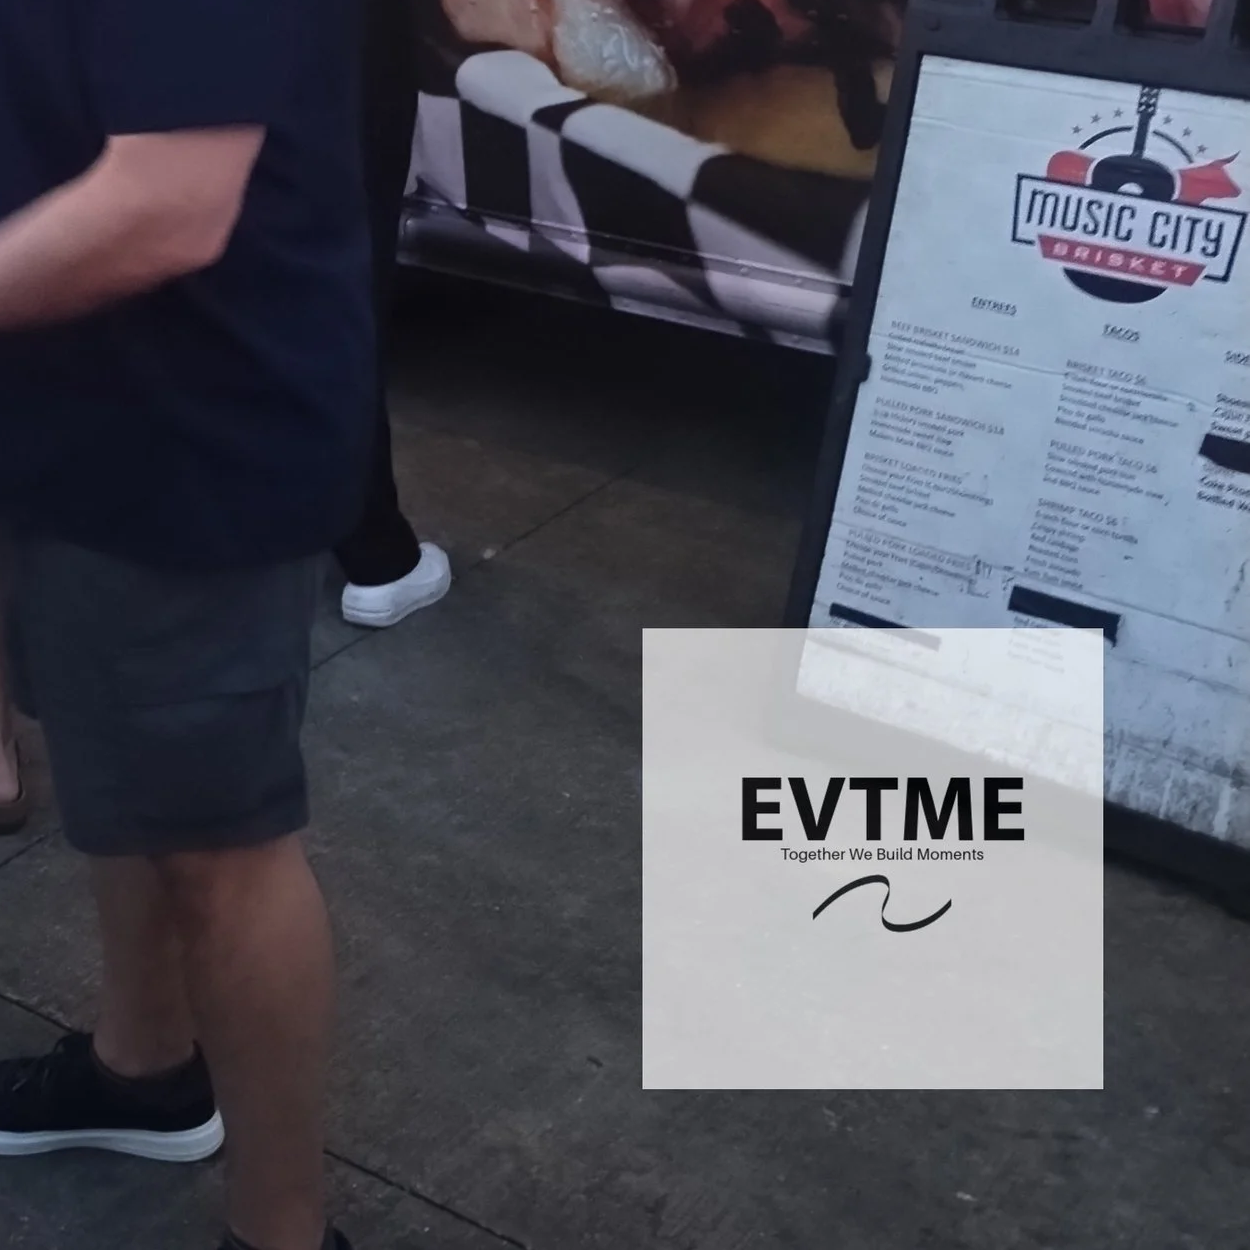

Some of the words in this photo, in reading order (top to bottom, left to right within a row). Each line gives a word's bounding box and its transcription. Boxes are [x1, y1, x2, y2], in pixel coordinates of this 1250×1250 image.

[1026, 188, 1137, 242] MUSIC
[1148, 211, 1225, 258] CITY
[1052, 243, 1189, 278] BRISKET
[913, 326, 948, 339] BRISKET
[951, 335, 1000, 351] SANDWICH
[1103, 324, 1140, 342] TACOS
[909, 406, 932, 416] PORK
[936, 412, 985, 429] SANDWICH
[1087, 449, 1114, 462] PORK
[1078, 509, 1102, 521] TACO
